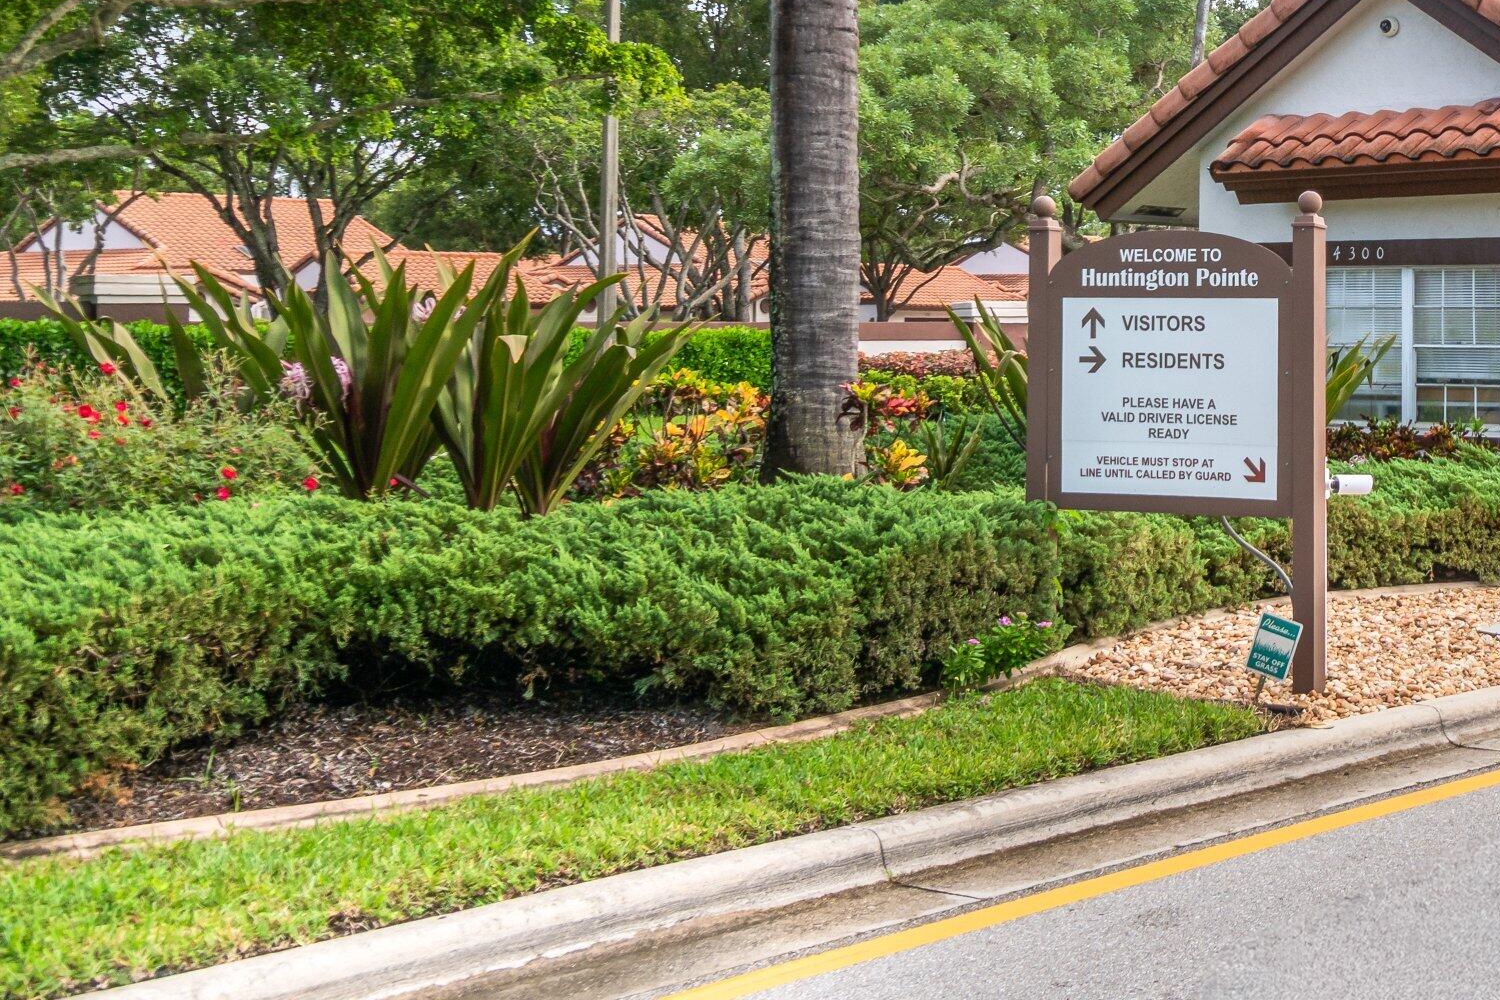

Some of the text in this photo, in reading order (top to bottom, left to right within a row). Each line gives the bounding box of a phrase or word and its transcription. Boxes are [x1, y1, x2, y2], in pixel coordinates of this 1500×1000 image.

[1120, 248, 1222, 263] WELCOME TO
[1333, 245, 1385, 261] 4300
[1081, 268, 1259, 290] Huntington Pointe
[1122, 315, 1206, 331] VISITORS
[1122, 352, 1225, 370] RESIDENTS
[1122, 397, 1217, 410] PLEASE HAVE A
[1101, 411, 1238, 426] VALID DRIVER LICENSE
[1148, 428, 1190, 440] READY
[1096, 455, 1214, 468] VEHICLE MUST STOP AT
[1080, 467, 1232, 482] LINE UNTIL CALLED BY GUARD
[1252, 652, 1286, 668] STAY OFF
[1255, 661, 1279, 673] GRASS
